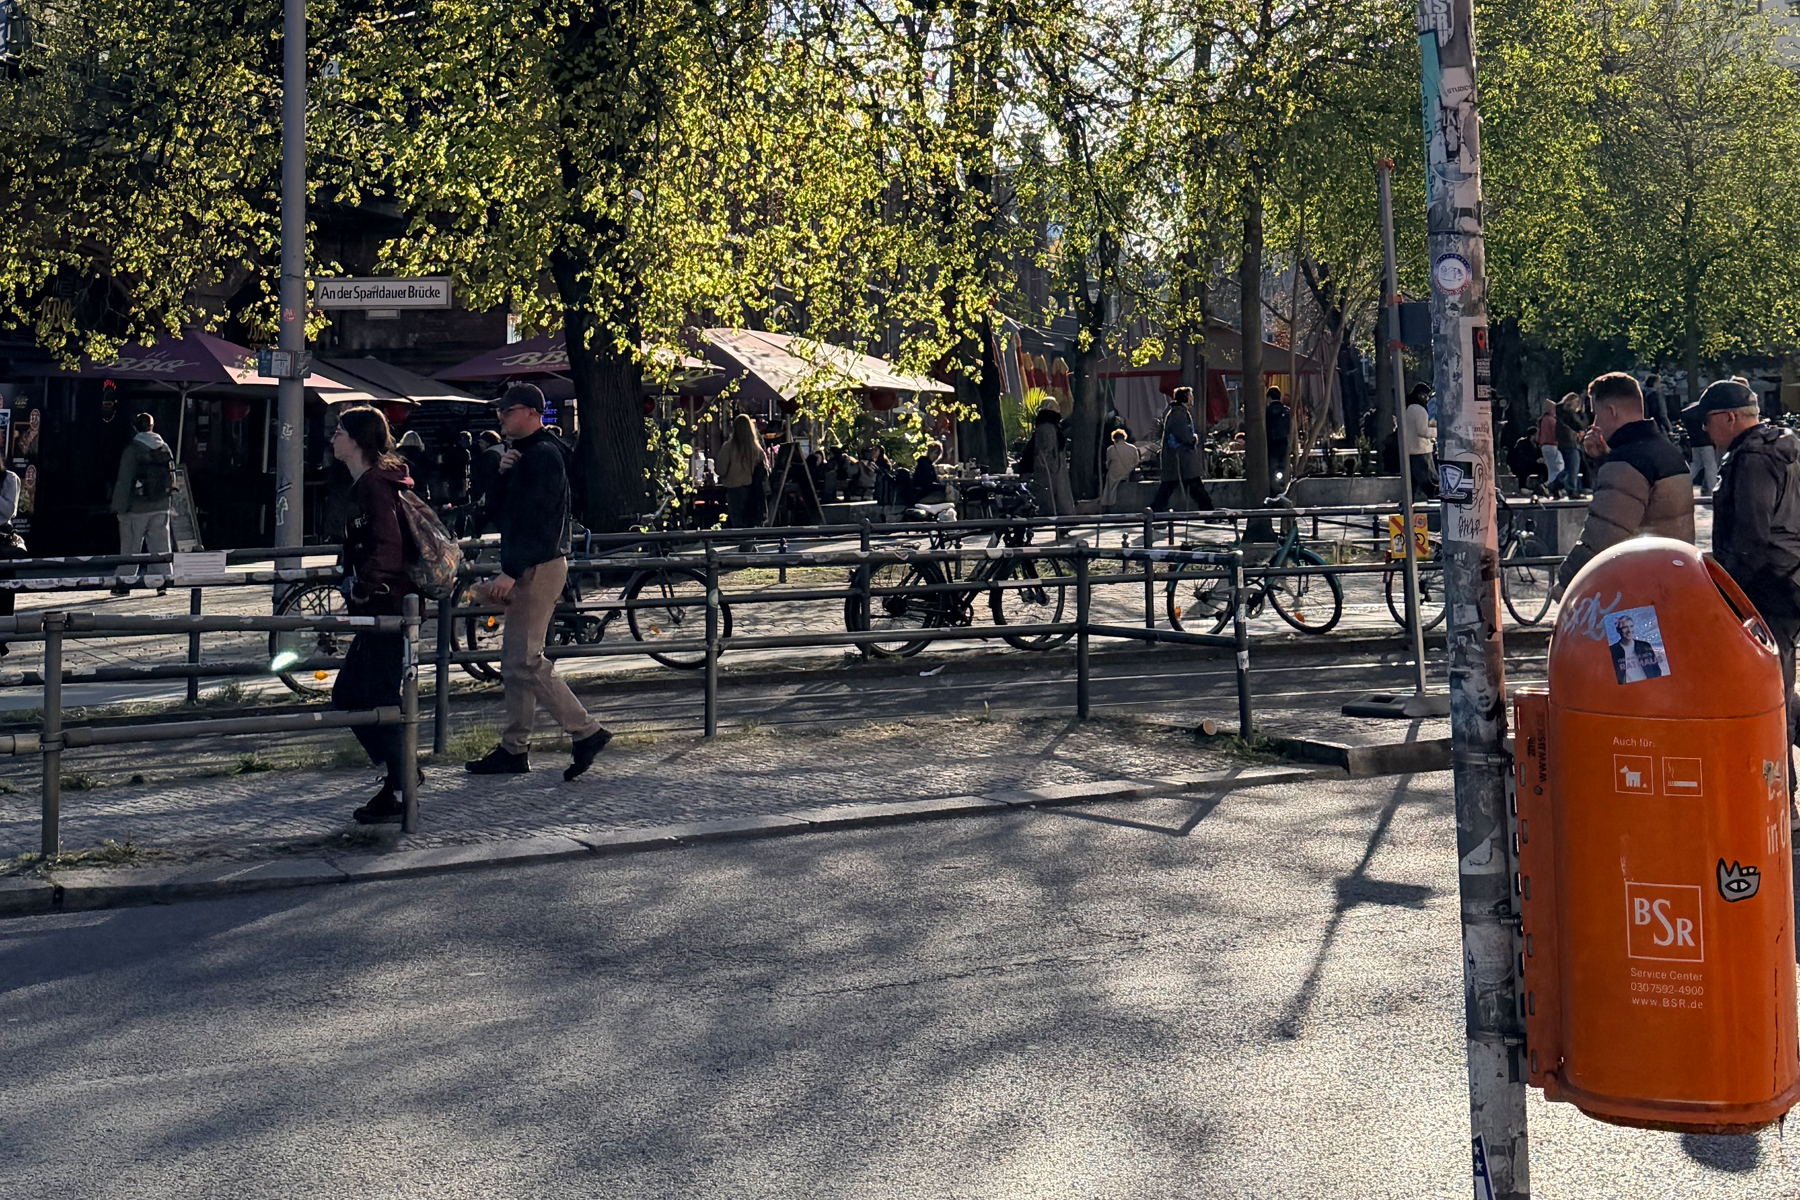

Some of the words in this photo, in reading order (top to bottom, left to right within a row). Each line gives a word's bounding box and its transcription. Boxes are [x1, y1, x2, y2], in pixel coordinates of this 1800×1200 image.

[320, 286, 336, 300] An
[337, 286, 353, 300] der
[408, 285, 441, 299] Brücke
[496, 350, 568, 366] BB
[1612, 736, 1637, 747] Auch
[1633, 898, 1696, 947] BSR
[1630, 967, 1667, 980] Service
[1669, 970, 1703, 982] Center
[1631, 997, 1704, 1009] www.BSR.de
